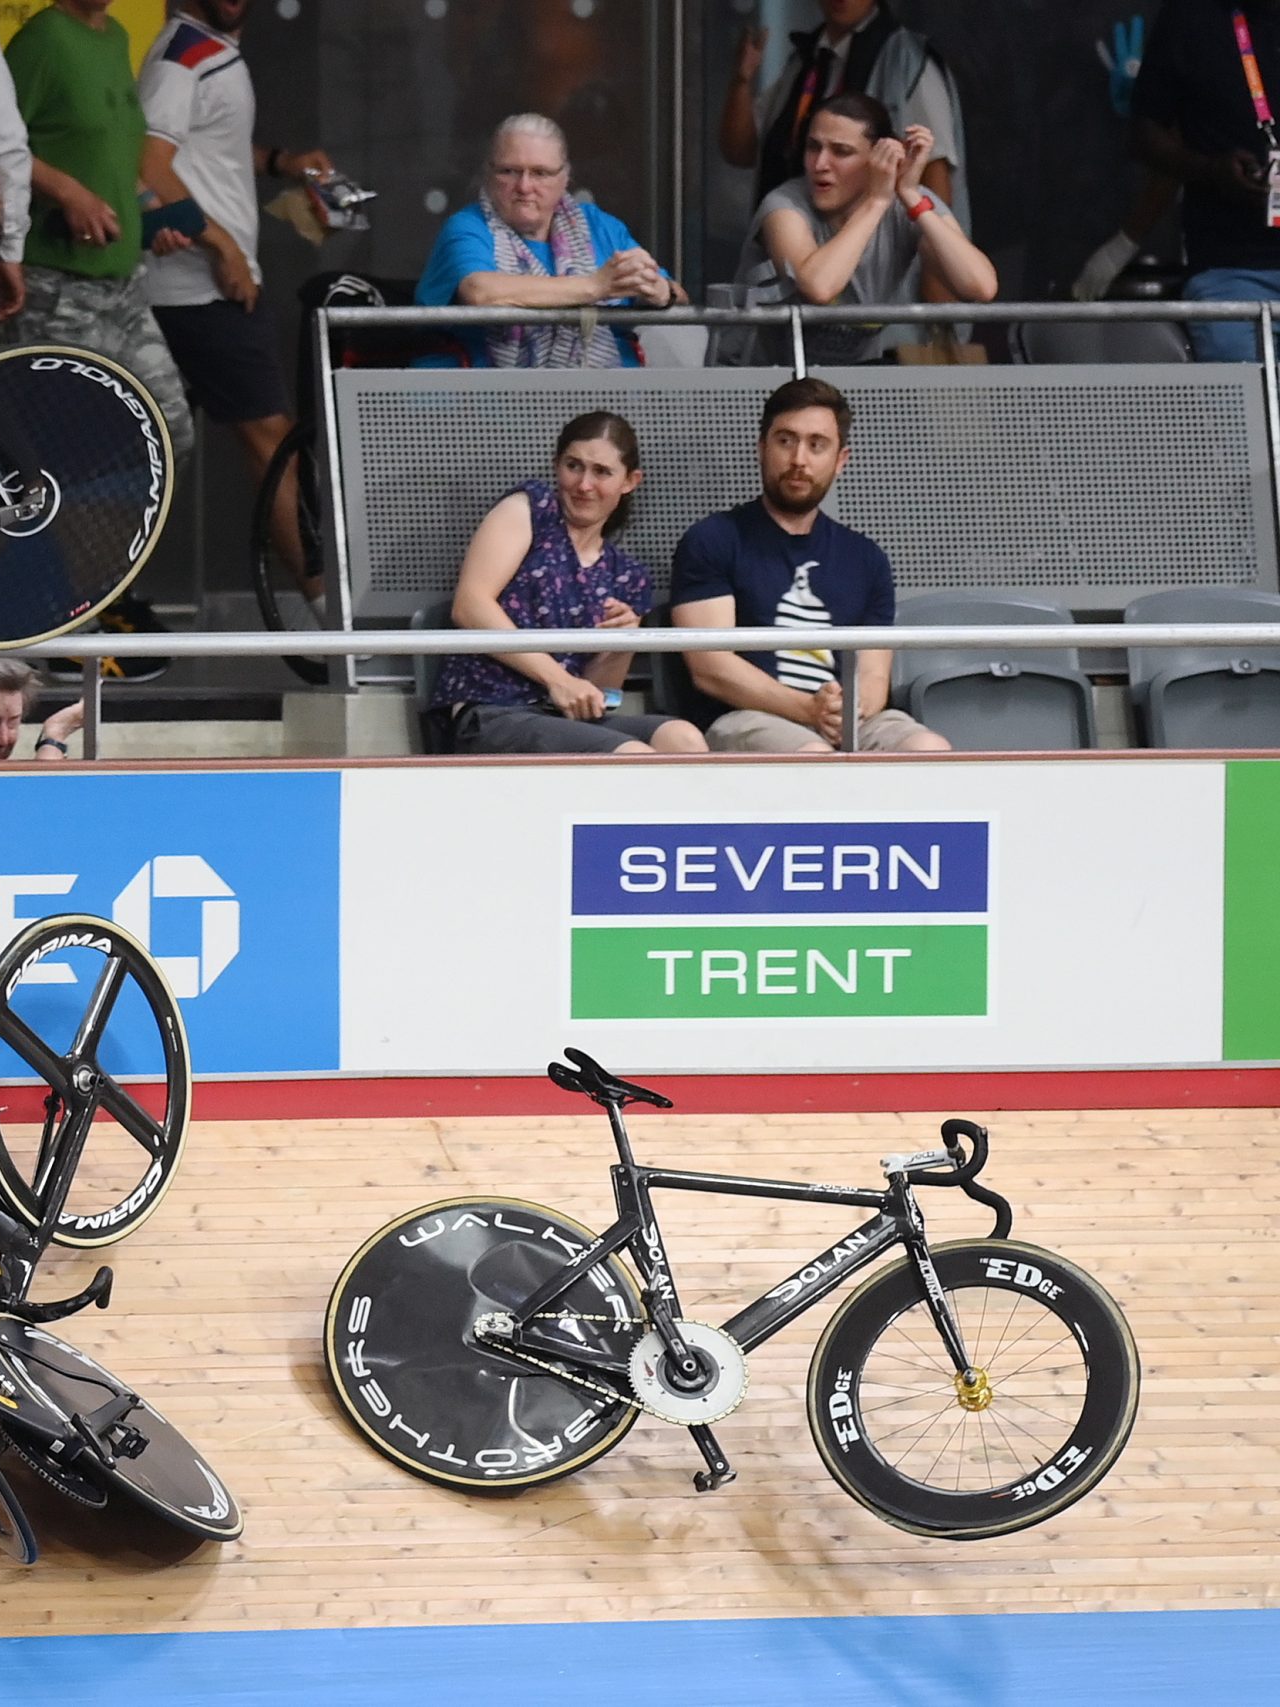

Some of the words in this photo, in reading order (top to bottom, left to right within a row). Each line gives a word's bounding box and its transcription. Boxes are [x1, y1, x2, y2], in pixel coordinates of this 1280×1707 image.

[30, 357, 163, 562] CAMPAGNOLO
[619, 844, 941, 893] SEVERN
[6, 932, 112, 1001] CORIMA
[646, 948, 912, 996] TRENT
[57, 1160, 163, 1230] CORIMA
[398, 1213, 629, 1334] WALKER
[641, 1221, 675, 1300] DOLAN
[764, 1231, 870, 1303] DOLAN
[347, 1296, 601, 1469] BROTHERS
